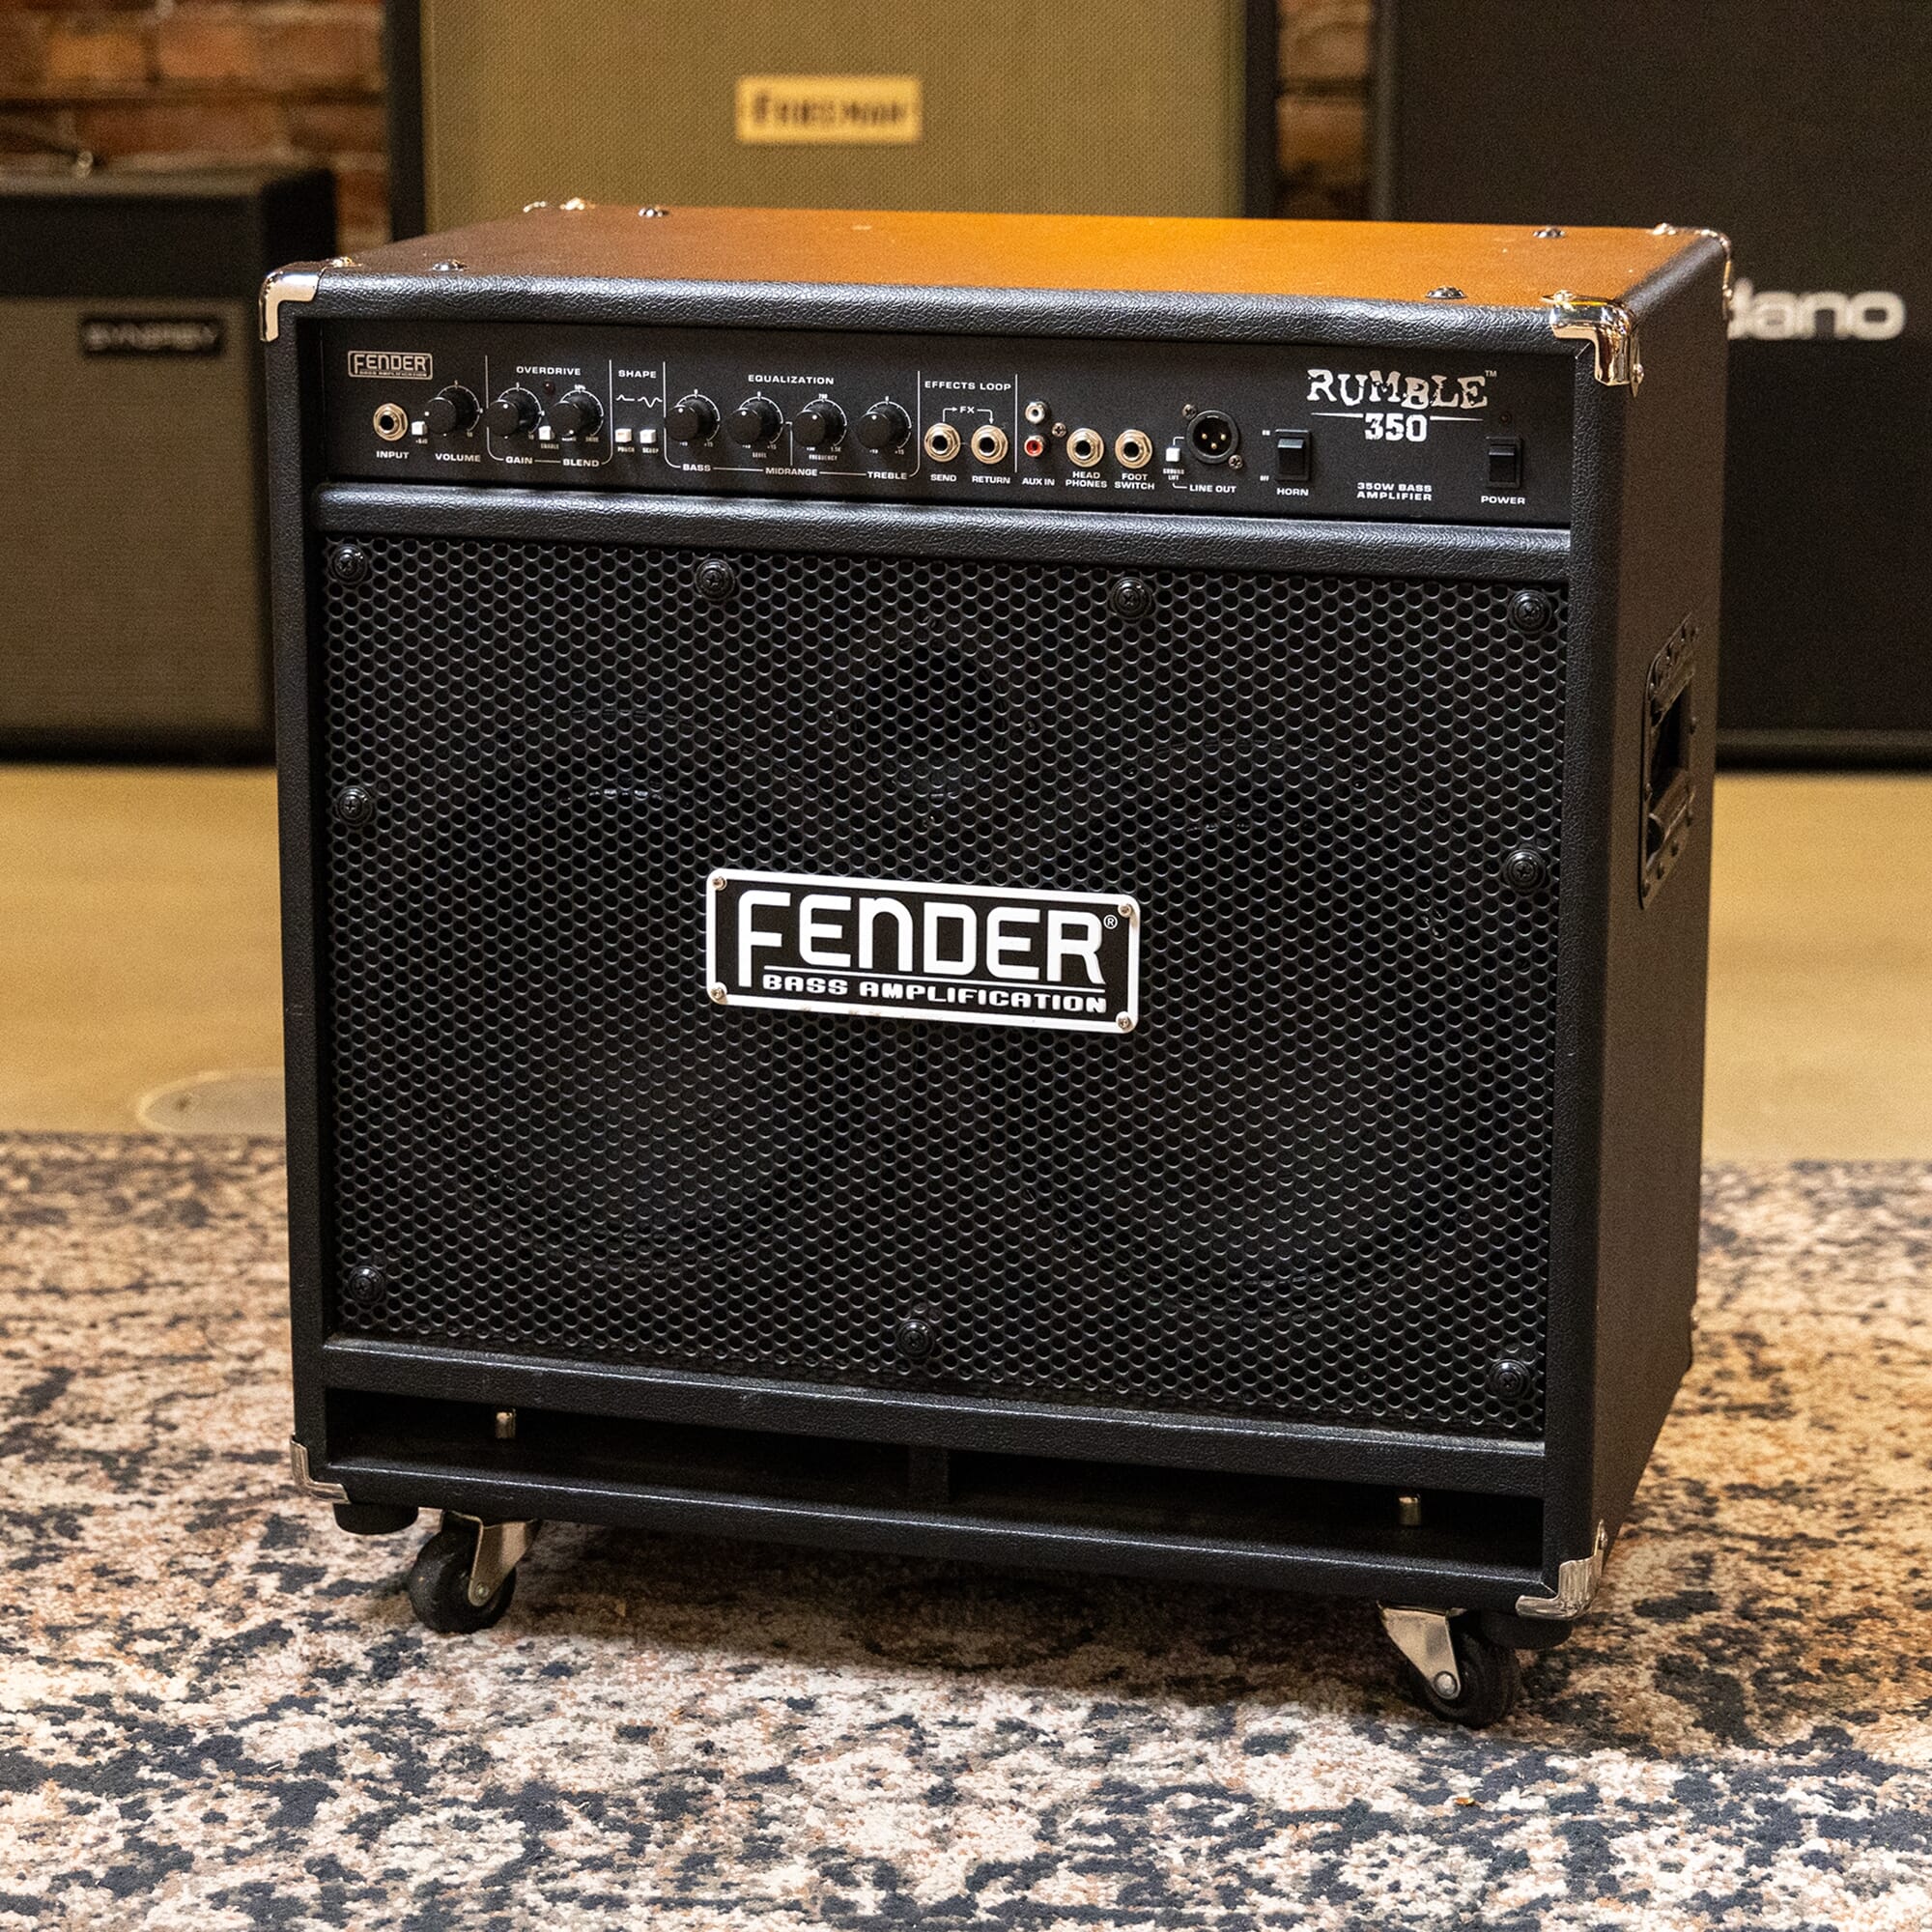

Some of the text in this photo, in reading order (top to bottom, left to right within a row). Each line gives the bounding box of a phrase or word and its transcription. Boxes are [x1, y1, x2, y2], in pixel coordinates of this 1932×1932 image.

[354, 354, 427, 374] FENDER
[516, 365, 582, 377] OVERDRIVE
[617, 369, 658, 379] SHAPE
[747, 374, 835, 385] EQUALIZATION
[924, 381, 1011, 392] EFFECTS LOOP
[1306, 368, 1489, 411] RUMBLE
[959, 405, 975, 414] FX
[1364, 412, 1428, 442] 350
[376, 450, 410, 460] INPUT
[435, 453, 481, 463] VOLUME
[505, 456, 533, 465] GAIN
[562, 458, 600, 468] BLEND
[765, 467, 818, 476] MIDRANGE
[867, 471, 908, 480] TREBLE
[1072, 470, 1100, 479] HEAD
[930, 473, 957, 482] SEND
[972, 475, 1011, 485] RETURN
[1022, 477, 1042, 486] AUX
[1065, 479, 1108, 489] PHONES
[1114, 482, 1155, 491] SWITCH
[1189, 484, 1237, 494] LINE OUT
[1356, 482, 1433, 493] 350W BASS
[1276, 487, 1309, 497] HORN
[1356, 492, 1433, 501] AMPLIFIER
[1480, 496, 1526, 505] POWER
[762, 973, 1107, 1014] BASS AMPLIFICATION
